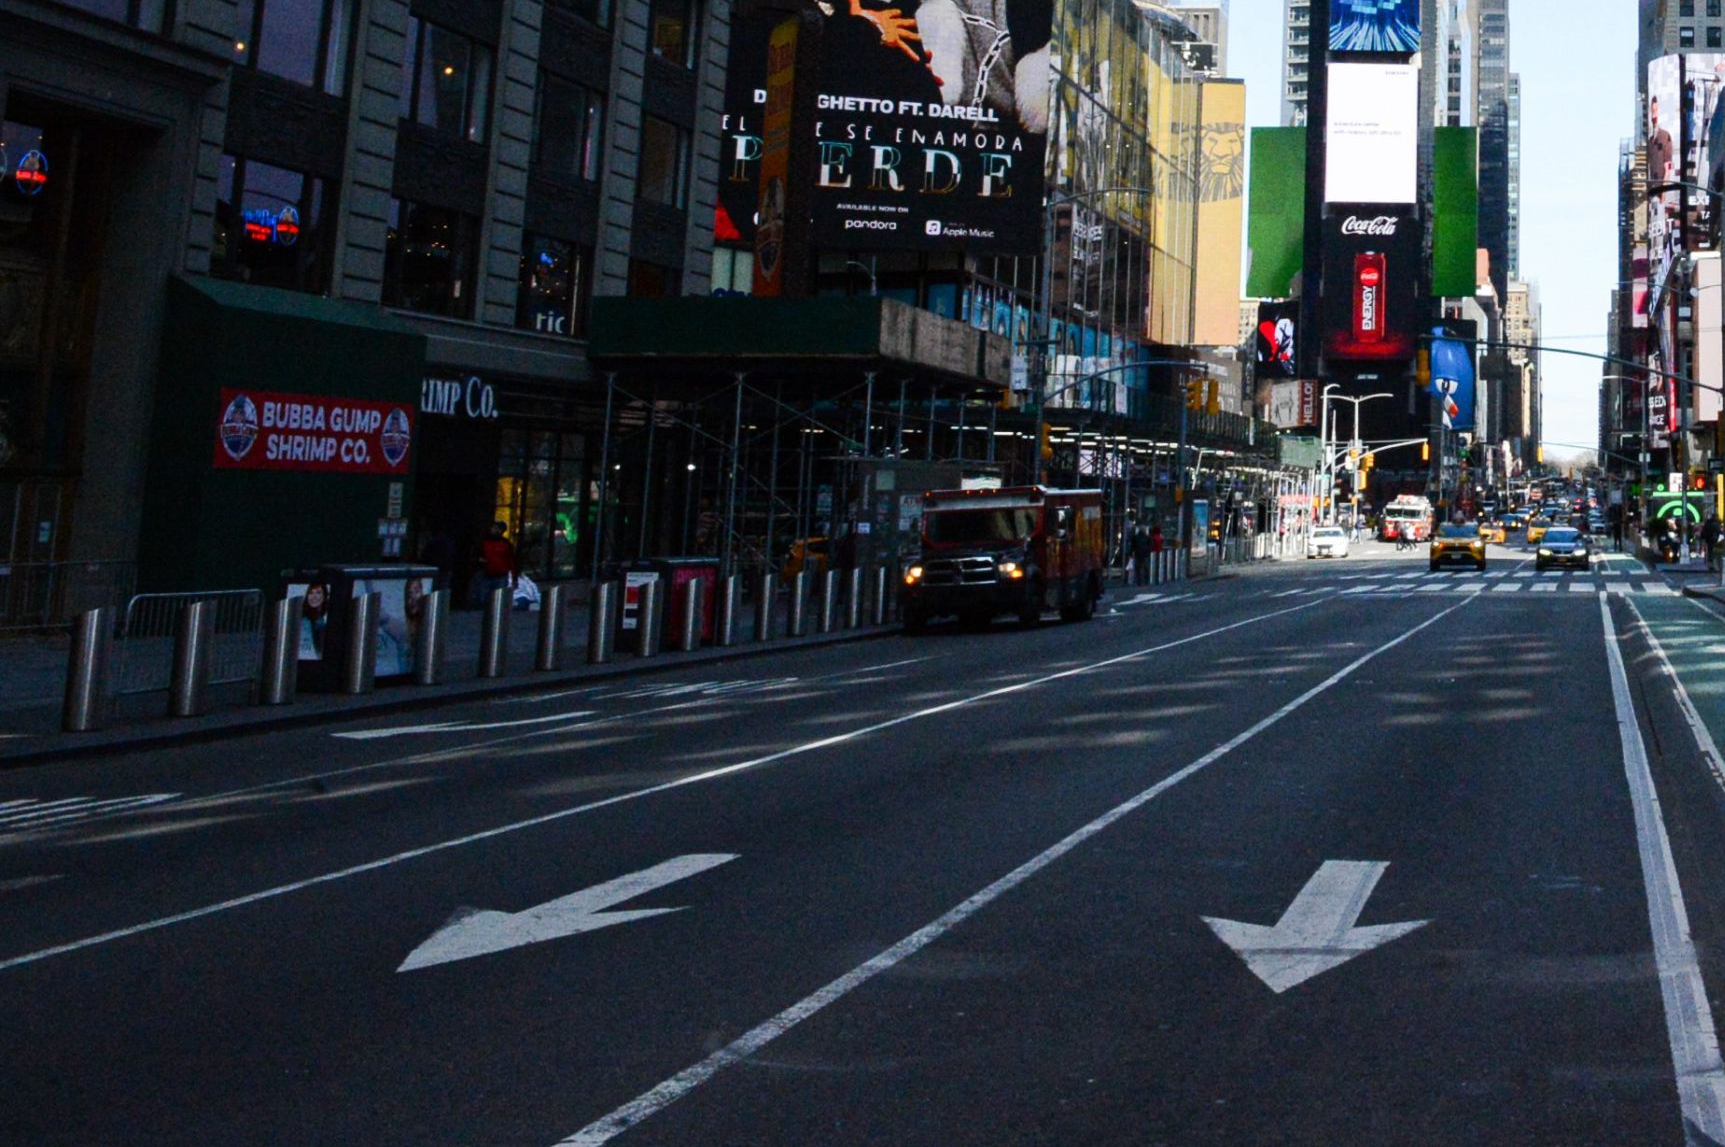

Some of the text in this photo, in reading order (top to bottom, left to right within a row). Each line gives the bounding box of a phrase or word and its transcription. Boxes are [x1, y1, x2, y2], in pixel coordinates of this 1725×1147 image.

[817, 94, 894, 114] GHETTO
[899, 101, 924, 116] FT.
[928, 103, 999, 122] DARELL
[847, 123, 872, 141] SE
[836, 202, 909, 214] AVAILABLE NOW ON
[845, 219, 897, 231] pandora
[942, 226, 995, 238] Apple Music
[1361, 285, 1373, 330] ENERGY
[1303, 382, 1313, 423] HELLO!
[262, 401, 326, 432] BUBBA
[329, 407, 381, 435] GUMP
[265, 434, 372, 464] SHRIMP CO.
